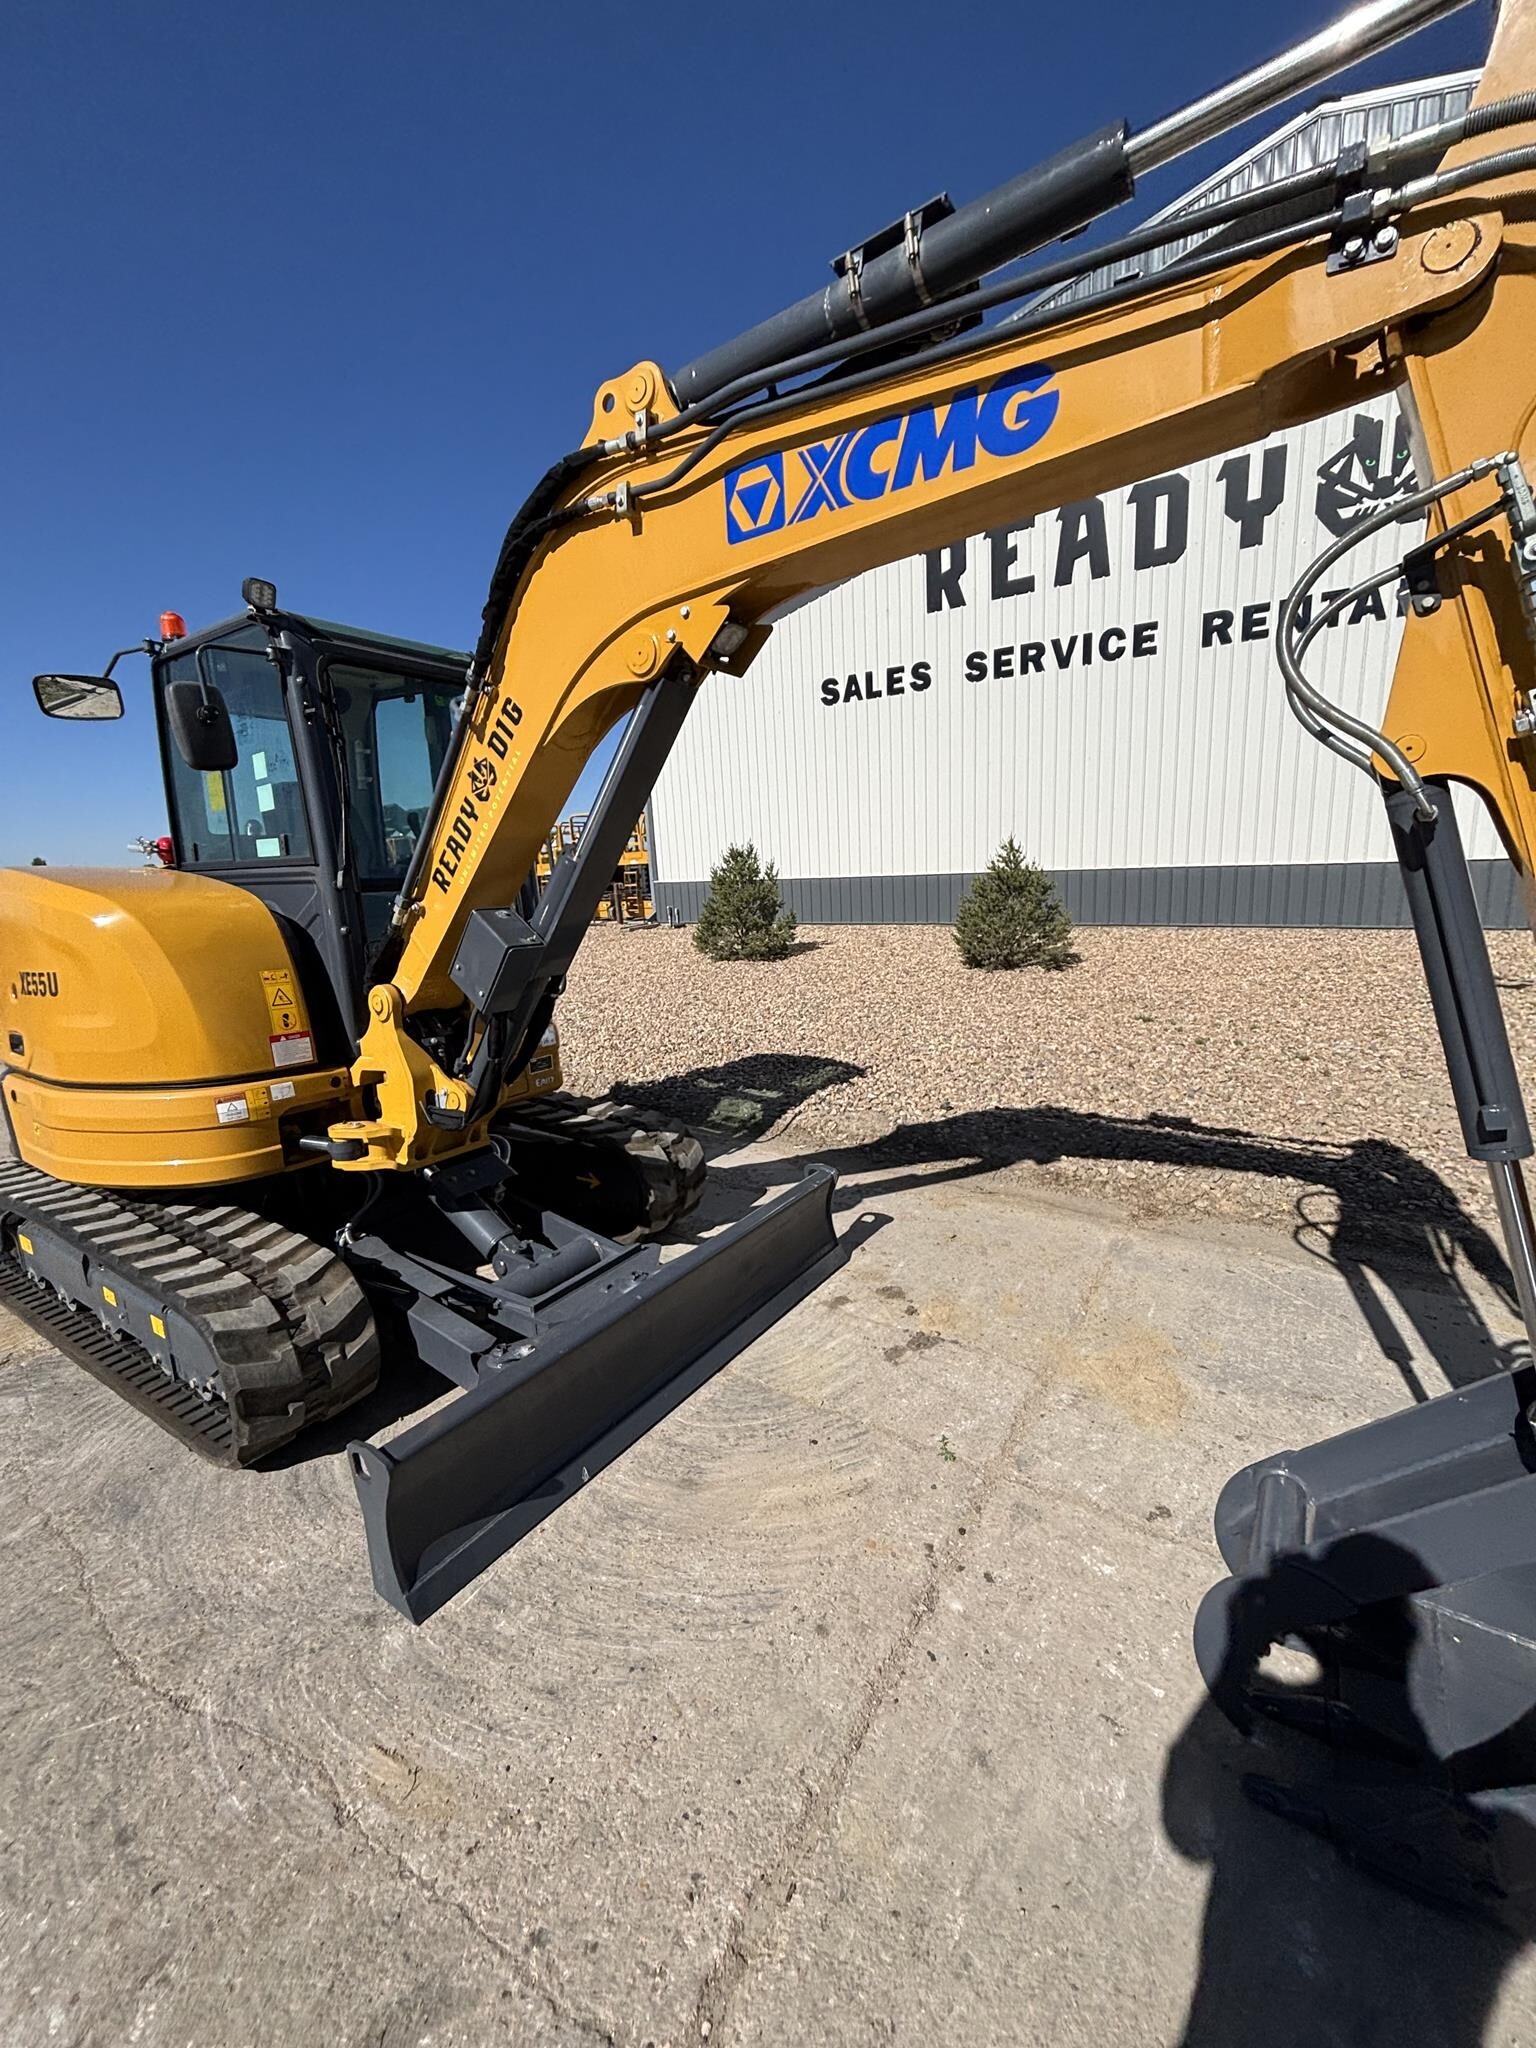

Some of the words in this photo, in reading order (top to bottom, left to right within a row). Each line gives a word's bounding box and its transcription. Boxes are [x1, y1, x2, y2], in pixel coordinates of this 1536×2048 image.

[786, 362, 1060, 526] XCMG
[923, 443, 1288, 614] READY
[820, 660, 932, 706] SALES
[964, 621, 1159, 682] SERVICE
[432, 797, 478, 893] READY
[488, 697, 523, 759] DIG
[459, 822, 488, 885] UNLIMITED
[488, 750, 521, 818] POTENTIAL
[19, 971, 59, 997] XE55U
